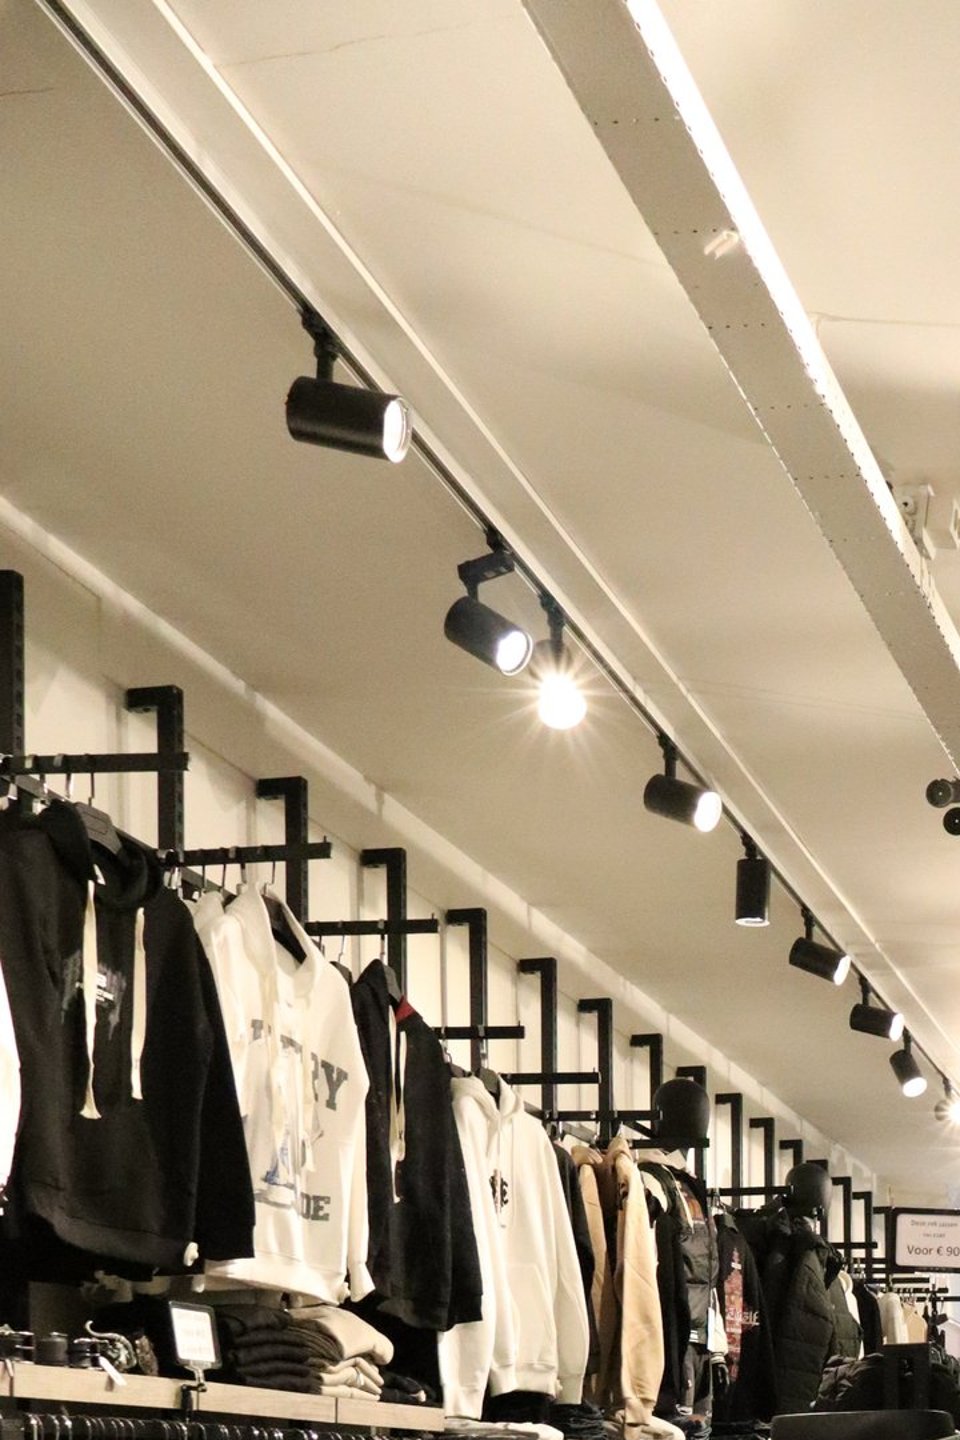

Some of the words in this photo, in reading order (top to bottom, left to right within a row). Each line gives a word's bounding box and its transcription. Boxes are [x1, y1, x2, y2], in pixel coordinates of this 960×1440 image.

[906, 1245, 934, 1256] Voor
[936, 1246, 944, 1256] €
[946, 1246, 960, 1257] 90
